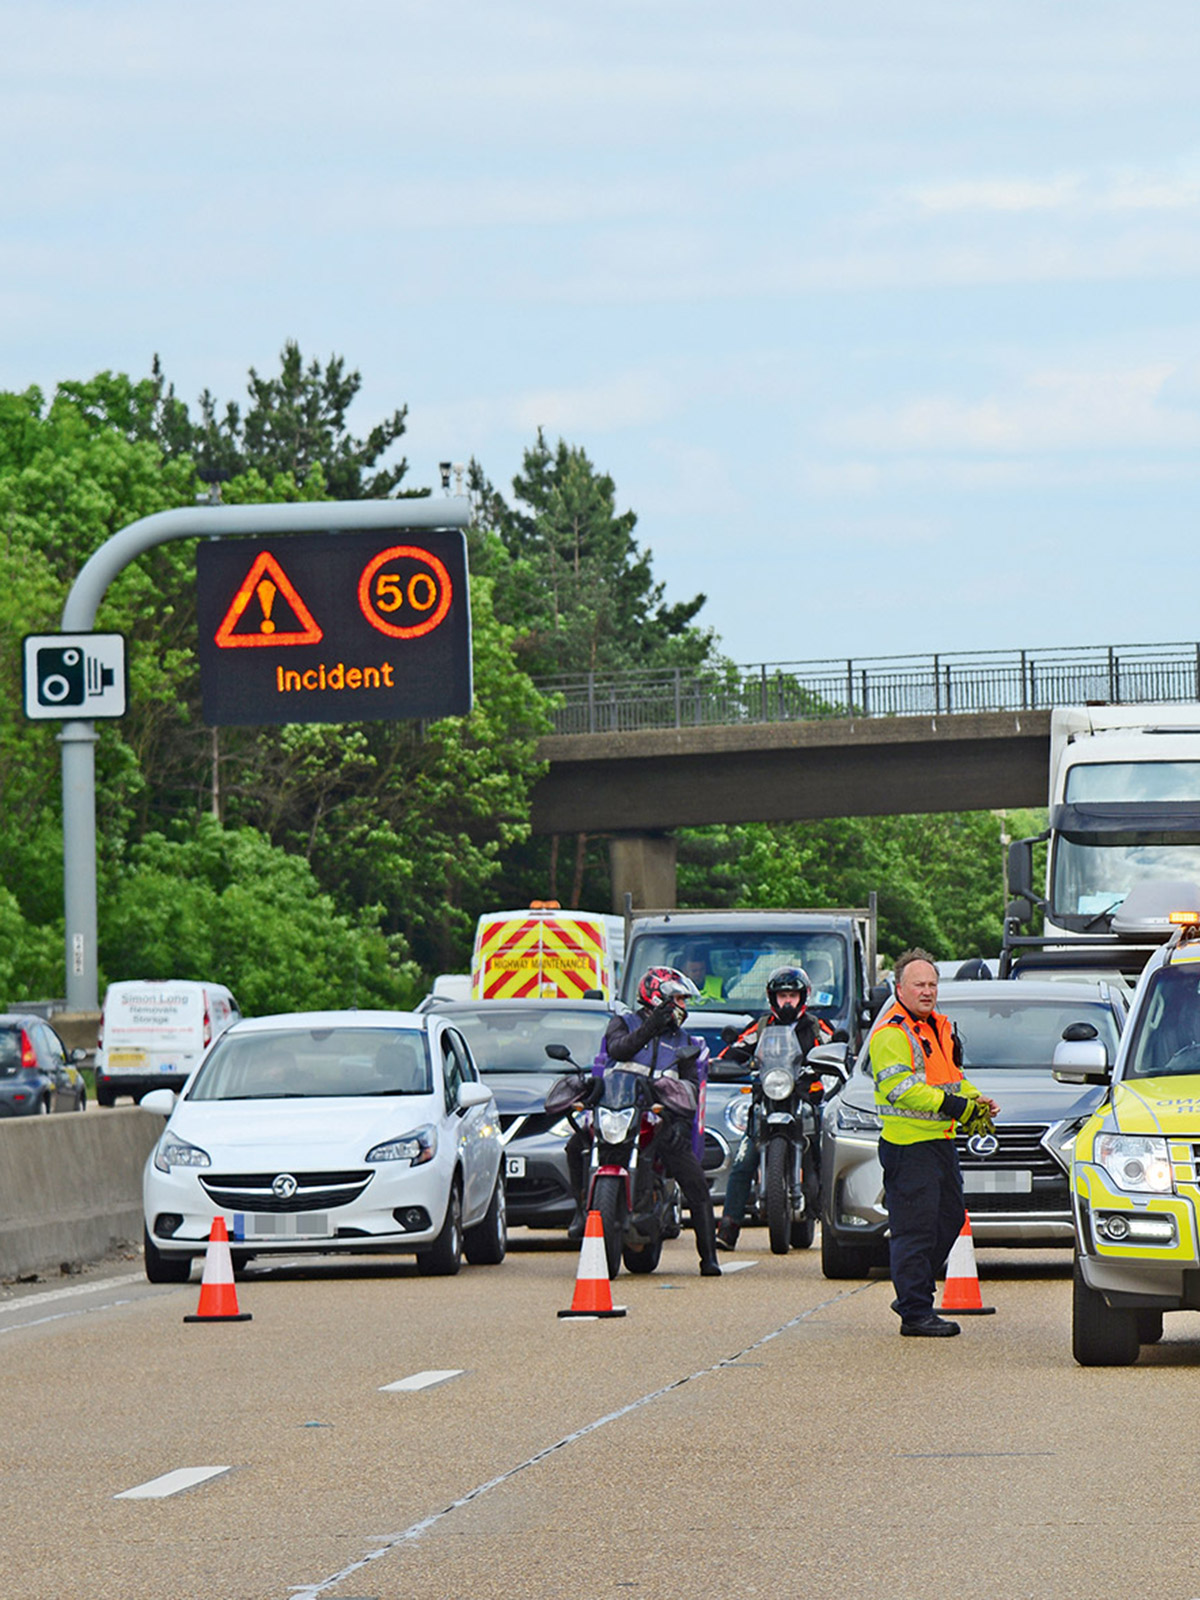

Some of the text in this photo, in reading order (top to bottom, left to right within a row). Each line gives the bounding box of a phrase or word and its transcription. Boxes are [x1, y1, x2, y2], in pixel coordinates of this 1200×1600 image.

[376, 573, 437, 612] 50
[276, 661, 394, 692] Incident
[494, 957, 587, 969] HIGHWAY MAINTENANCE
[121, 993, 189, 1005] Simon Long
[129, 1006, 178, 1014] Removals
